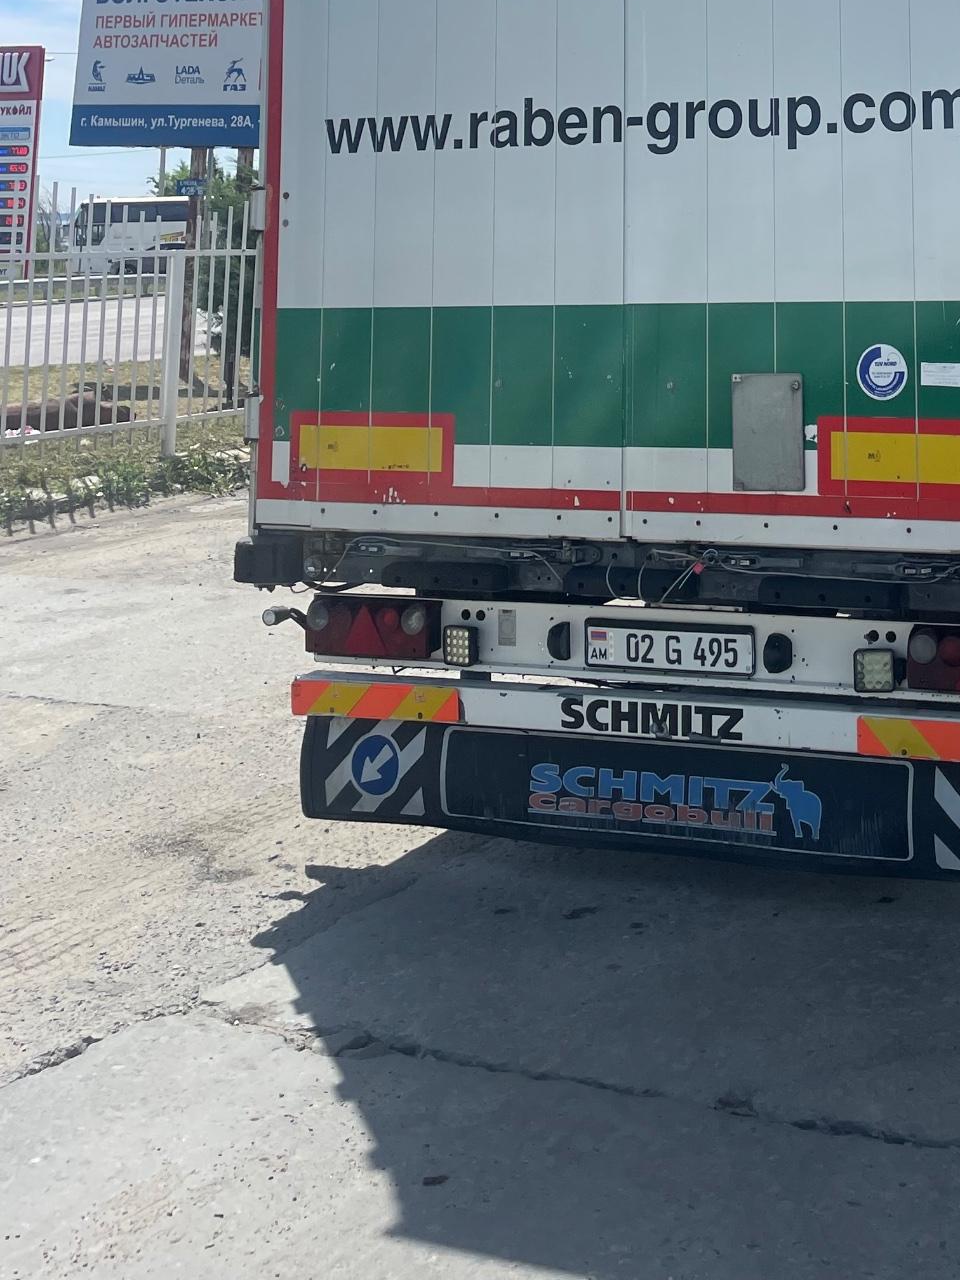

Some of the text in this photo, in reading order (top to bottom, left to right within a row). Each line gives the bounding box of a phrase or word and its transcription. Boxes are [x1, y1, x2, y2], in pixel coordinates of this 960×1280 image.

[95, 12, 156, 29] ПЕРВЫЙ
[93, 30, 218, 49] АВТОЗАПЧАСТЕЙ
[176, 65, 200, 75] LADA
[90, 115, 148, 128] Камышин,
[590, 647, 607, 660] AM
[626, 633, 738, 668] 02 G 495
[561, 697, 744, 741] SCHMITZ
[529, 762, 775, 814] SCHMITZ
